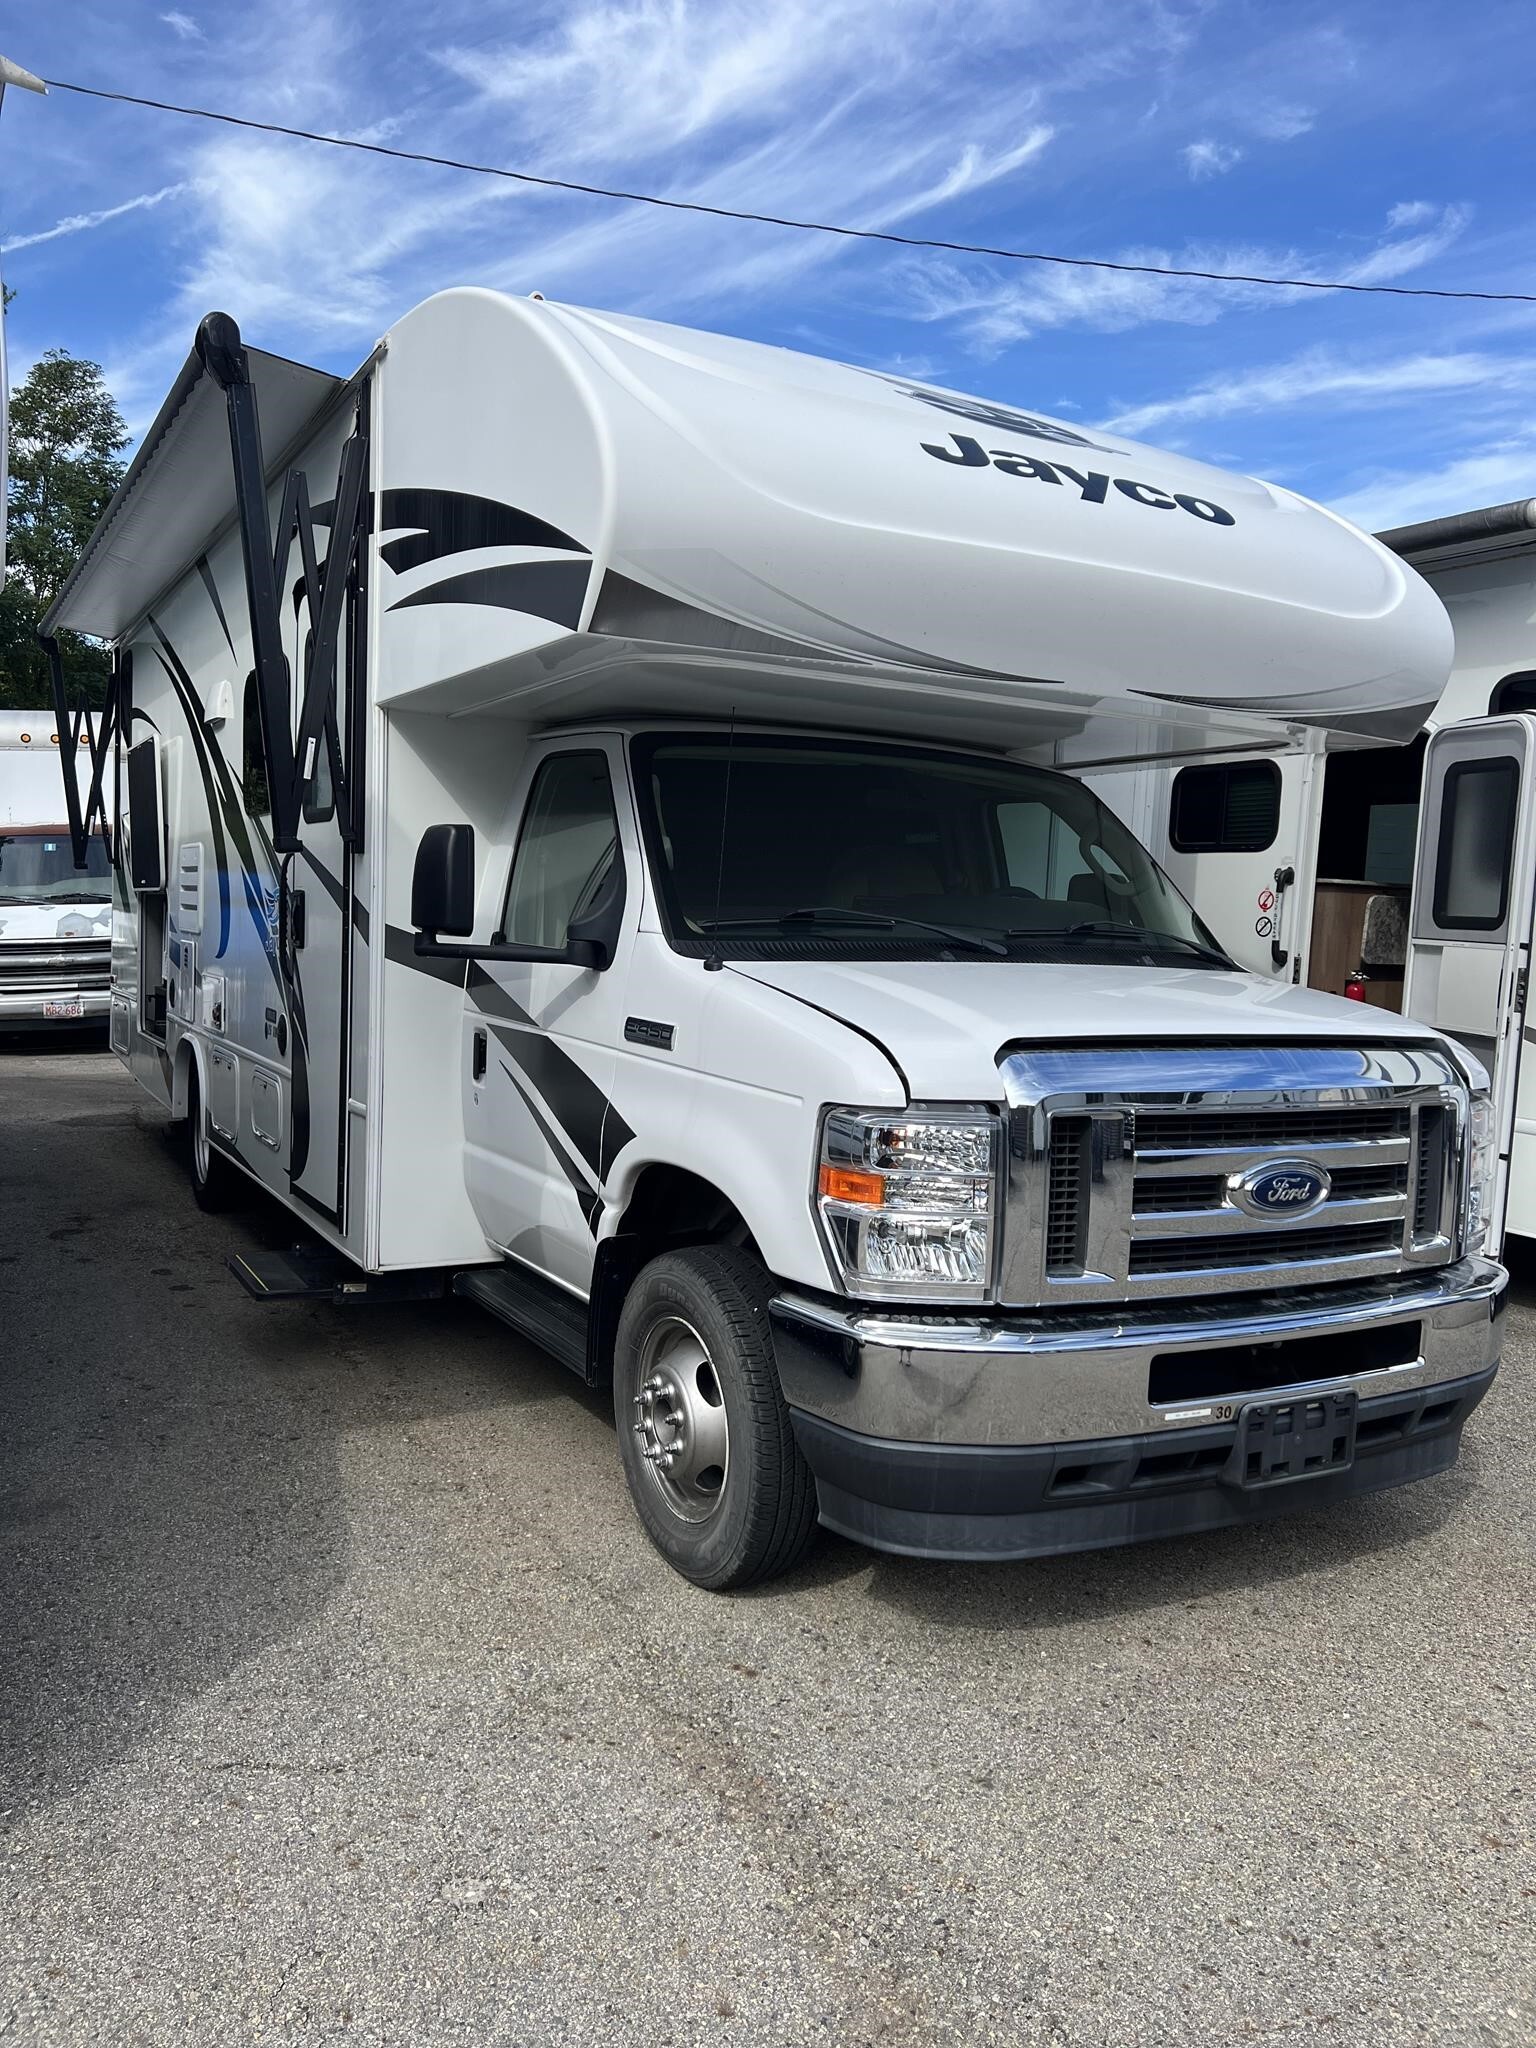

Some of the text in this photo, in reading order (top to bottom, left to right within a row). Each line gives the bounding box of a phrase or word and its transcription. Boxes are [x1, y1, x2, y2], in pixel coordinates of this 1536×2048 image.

[919, 432, 1236, 526] Jayco
[1268, 1177, 1311, 1202] Ford
[1215, 1406, 1232, 1419] 30
